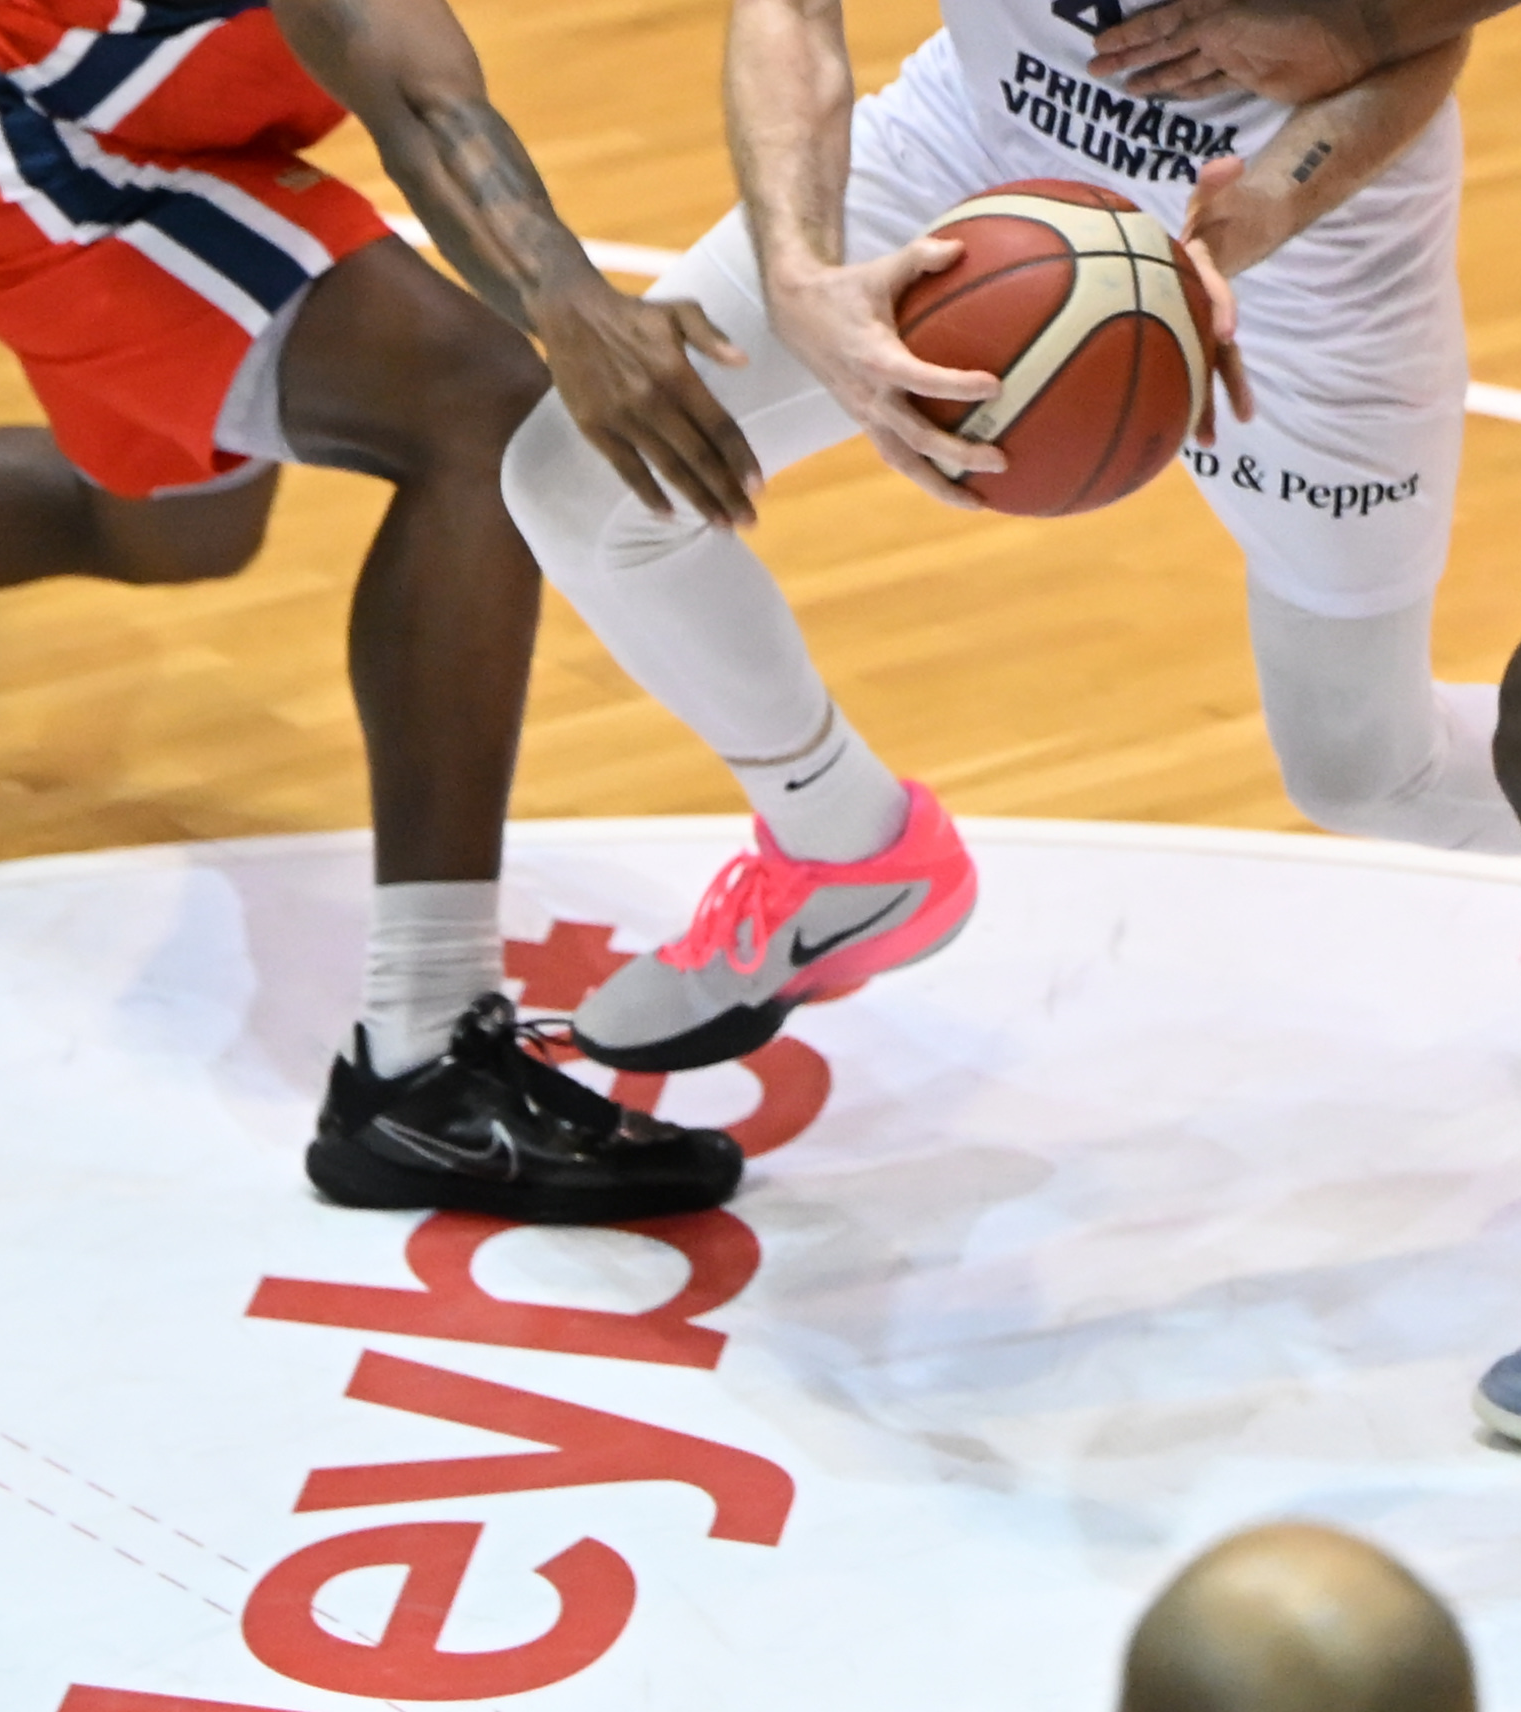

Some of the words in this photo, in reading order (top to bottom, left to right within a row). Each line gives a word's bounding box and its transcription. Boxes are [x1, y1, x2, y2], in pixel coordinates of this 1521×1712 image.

[999, 78, 1201, 185] VOLUNTA
[1231, 454, 1265, 493] &
[1280, 469, 1420, 519] Pepper
